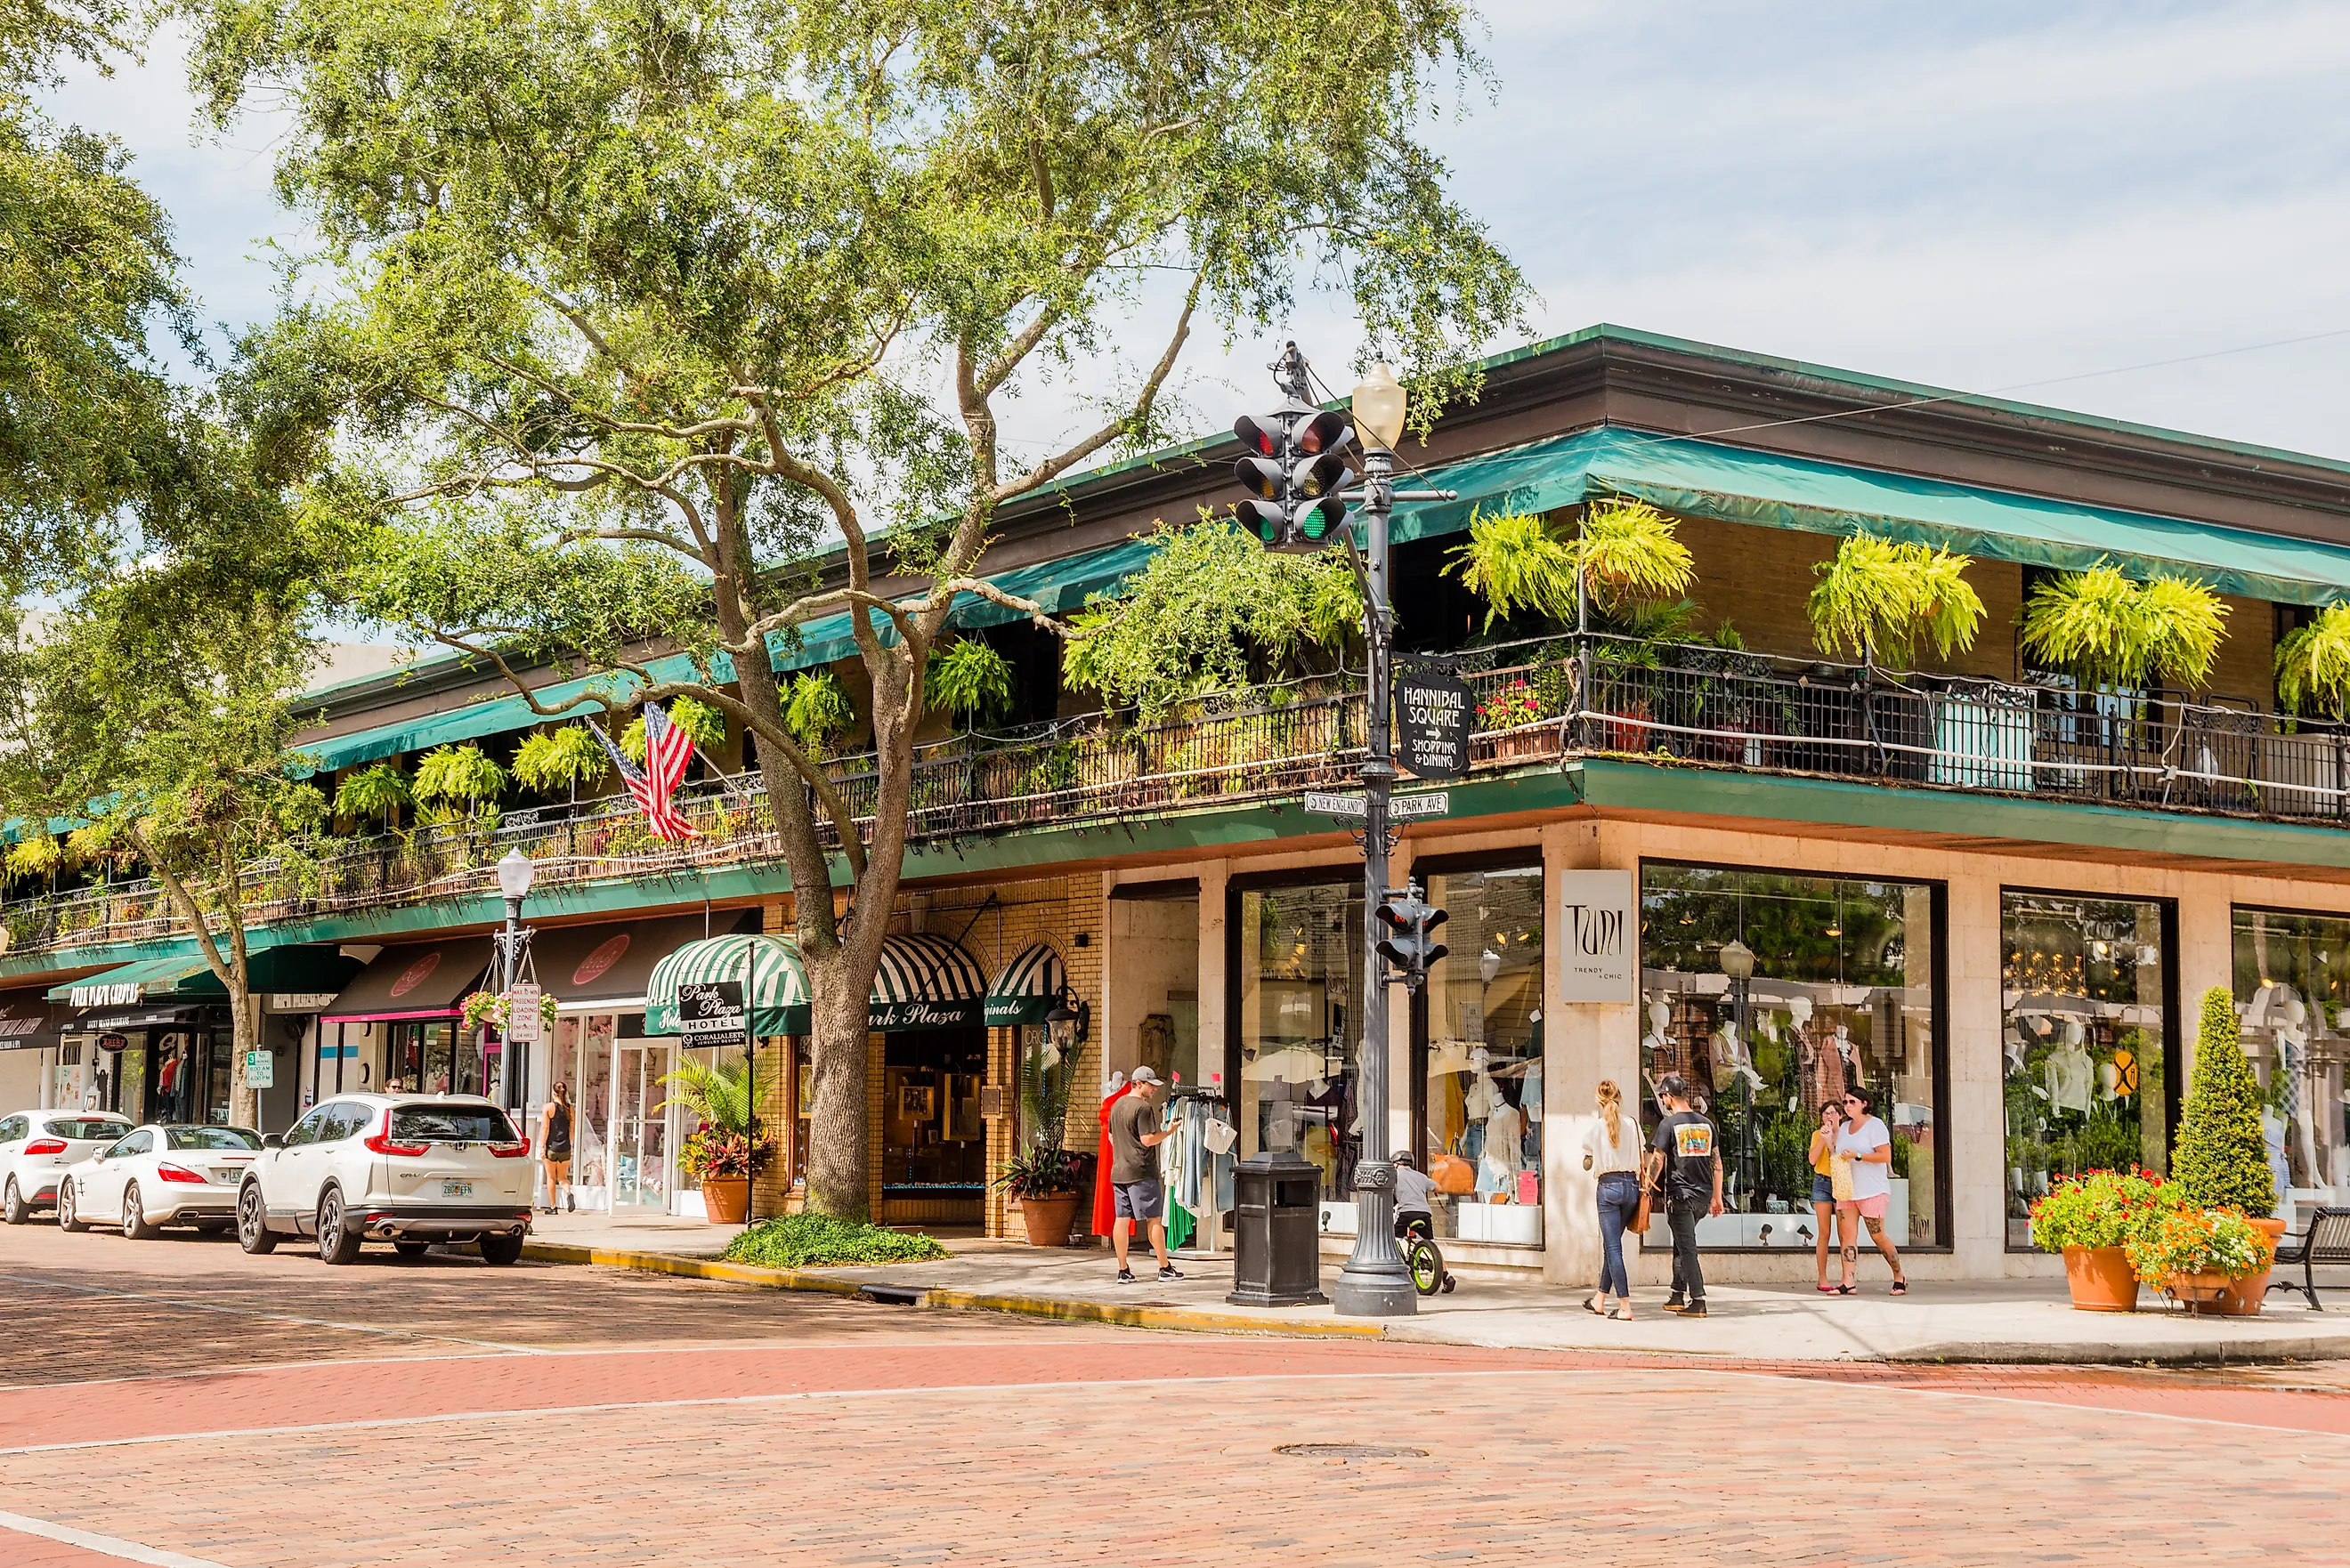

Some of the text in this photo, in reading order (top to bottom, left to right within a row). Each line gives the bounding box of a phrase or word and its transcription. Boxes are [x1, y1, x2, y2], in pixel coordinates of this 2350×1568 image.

[1404, 686, 1465, 709] HANNIBAL
[1408, 707, 1461, 728] SQUARE
[1411, 739, 1457, 756] SHOPPING
[1318, 796, 1332, 810] NEW
[1333, 797, 1358, 812] ENGLAND
[1402, 797, 1442, 814] PARK AVE
[680, 983, 719, 1002] Park
[698, 998, 742, 1020] Plaza
[868, 1003, 967, 1027] ark Plaza
[688, 1019, 738, 1030] HOTEL
[694, 1031, 745, 1042] CORALIALEETS
[249, 1055, 255, 1063] 3
